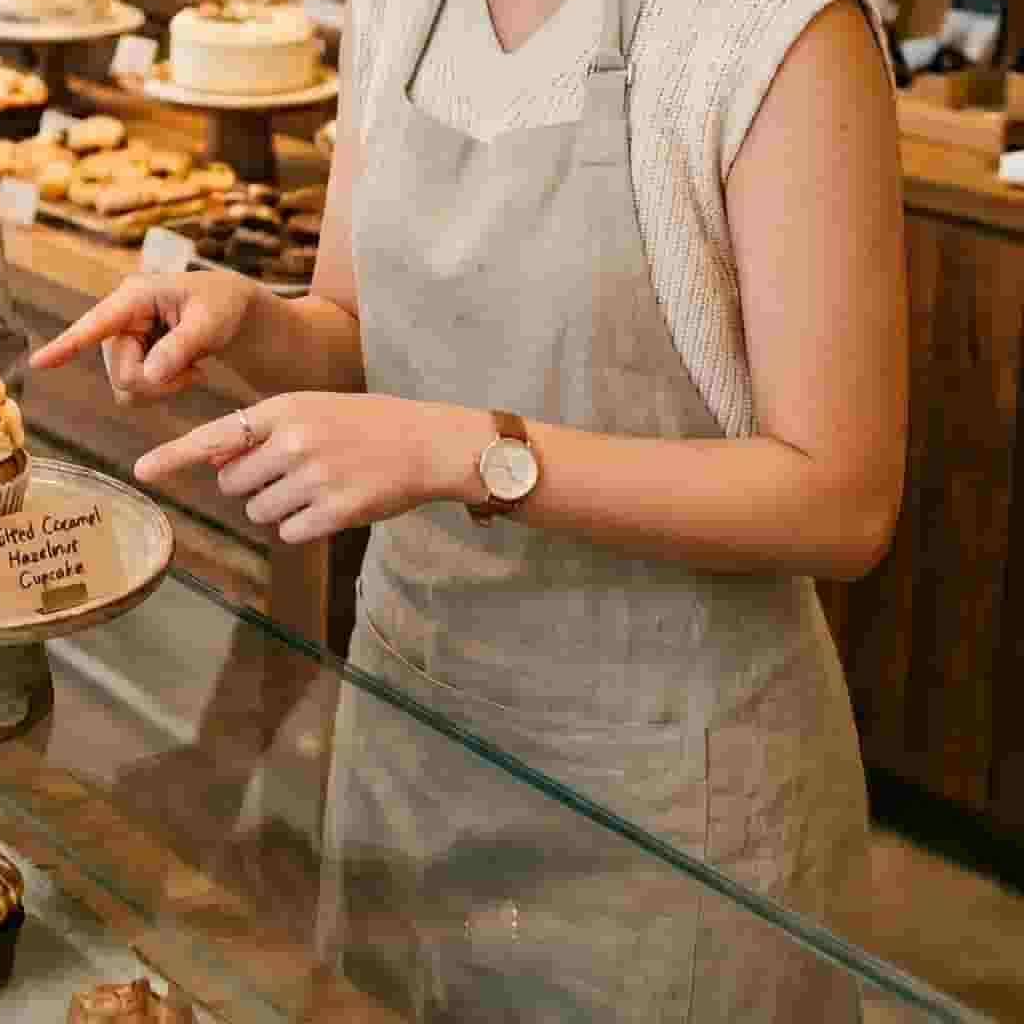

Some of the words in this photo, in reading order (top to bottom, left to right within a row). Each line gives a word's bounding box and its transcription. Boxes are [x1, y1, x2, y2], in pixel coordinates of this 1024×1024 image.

[42, 504, 102, 535] Caramel
[8, 538, 80, 569] Hazelnut
[19, 560, 84, 590] Cupcake
